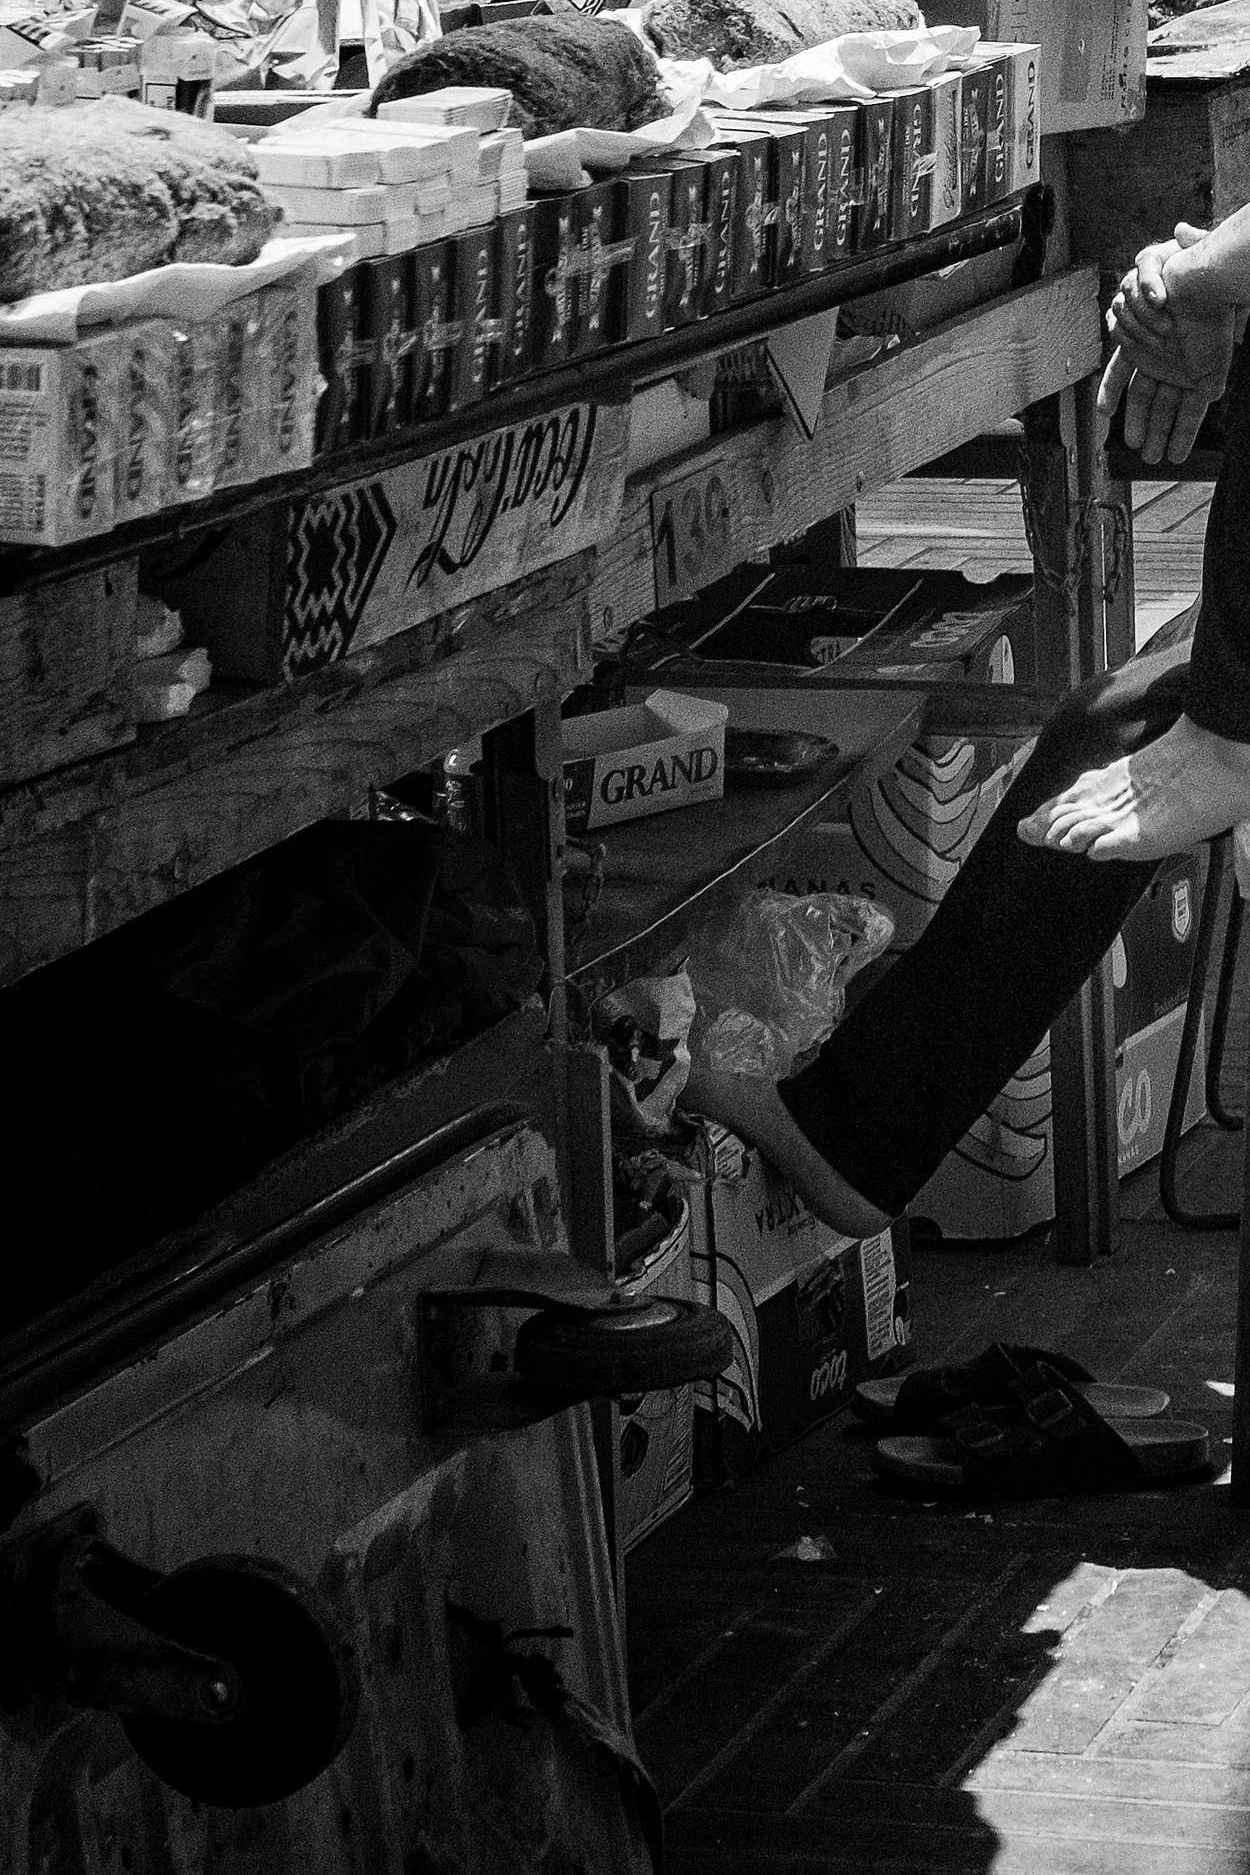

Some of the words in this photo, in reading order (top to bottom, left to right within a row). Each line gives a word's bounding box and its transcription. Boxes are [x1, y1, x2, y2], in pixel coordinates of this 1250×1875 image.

[994, 73, 1005, 183] GRAND
[1026, 60, 1036, 170] GRAND
[813, 132, 828, 251] GRAND
[836, 128, 851, 246] GRAND
[645, 191, 661, 319] GRAND
[600, 746, 718, 805] GRAND
